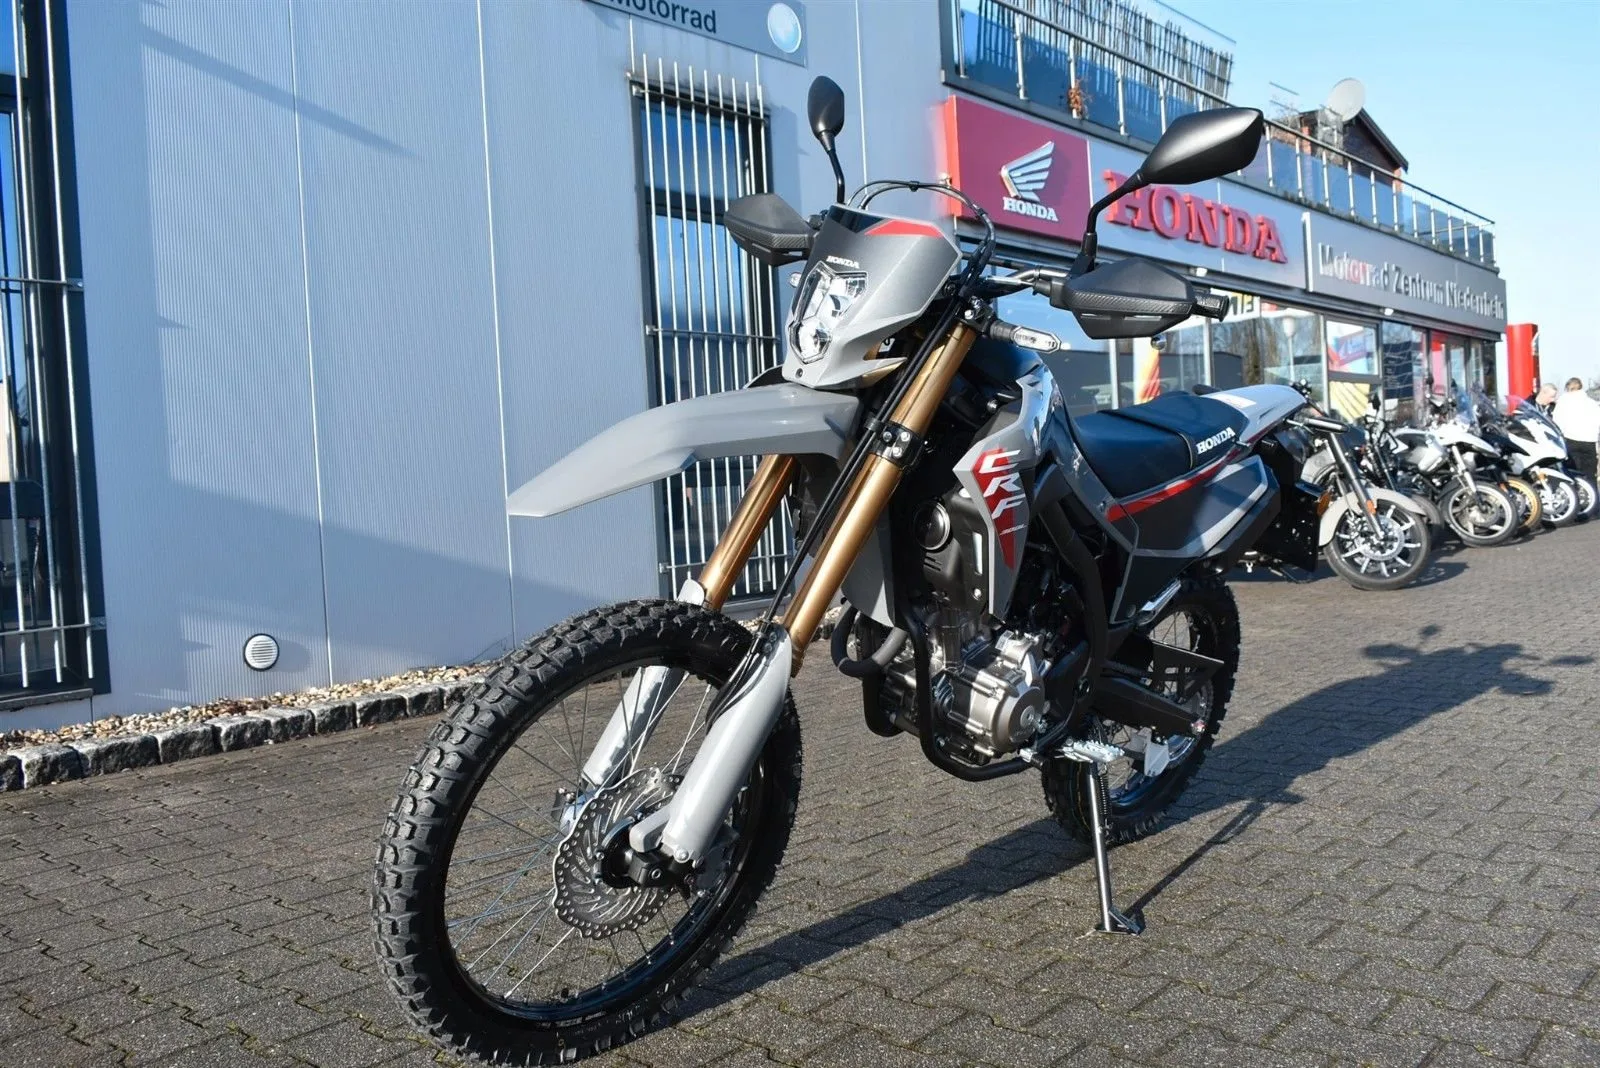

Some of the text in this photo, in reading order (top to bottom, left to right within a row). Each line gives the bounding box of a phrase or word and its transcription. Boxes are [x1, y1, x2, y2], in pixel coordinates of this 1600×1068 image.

[609, 0, 717, 33] otorrad
[1002, 196, 1059, 222] HONDA
[1103, 169, 1287, 264] HONDA
[826, 255, 860, 269] HONDA
[1318, 242, 1389, 290] Motorrad
[1391, 263, 1443, 305] Zentrum
[1195, 426, 1236, 454] HONDA
[979, 449, 1026, 520] CRF
